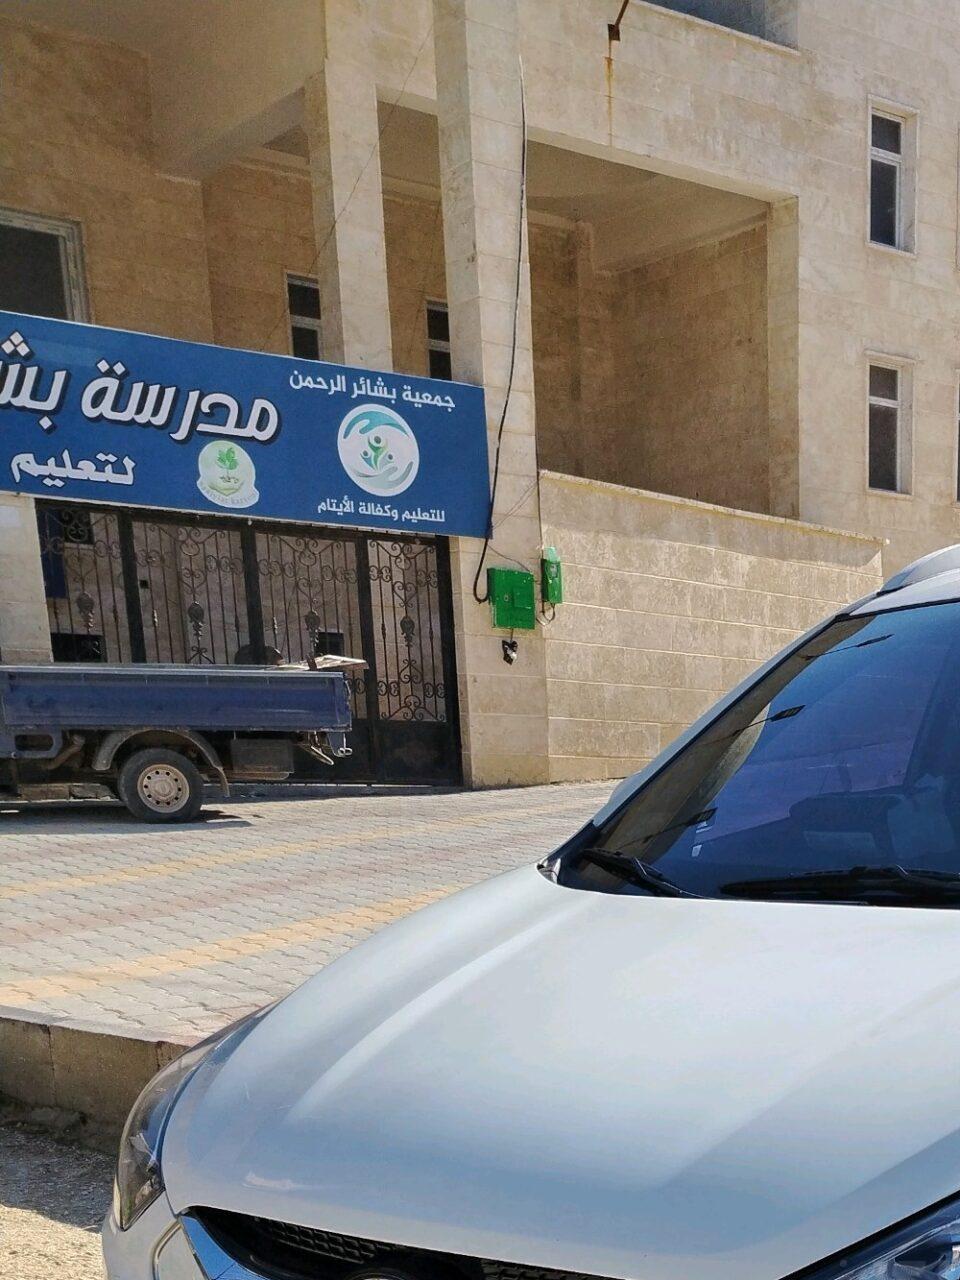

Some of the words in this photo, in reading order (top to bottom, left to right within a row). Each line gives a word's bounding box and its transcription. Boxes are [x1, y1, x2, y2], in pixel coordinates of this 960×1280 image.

[289, 370, 346, 395] الرحمن
[351, 377, 396, 404] بشائر
[81, 359, 278, 441] مدرسة
[402, 384, 455, 412] جمعية
[10, 449, 136, 488] لتعليم
[317, 495, 354, 516] الأيتام
[358, 502, 399, 521] وكفالة
[401, 507, 445, 523] للتعليم
